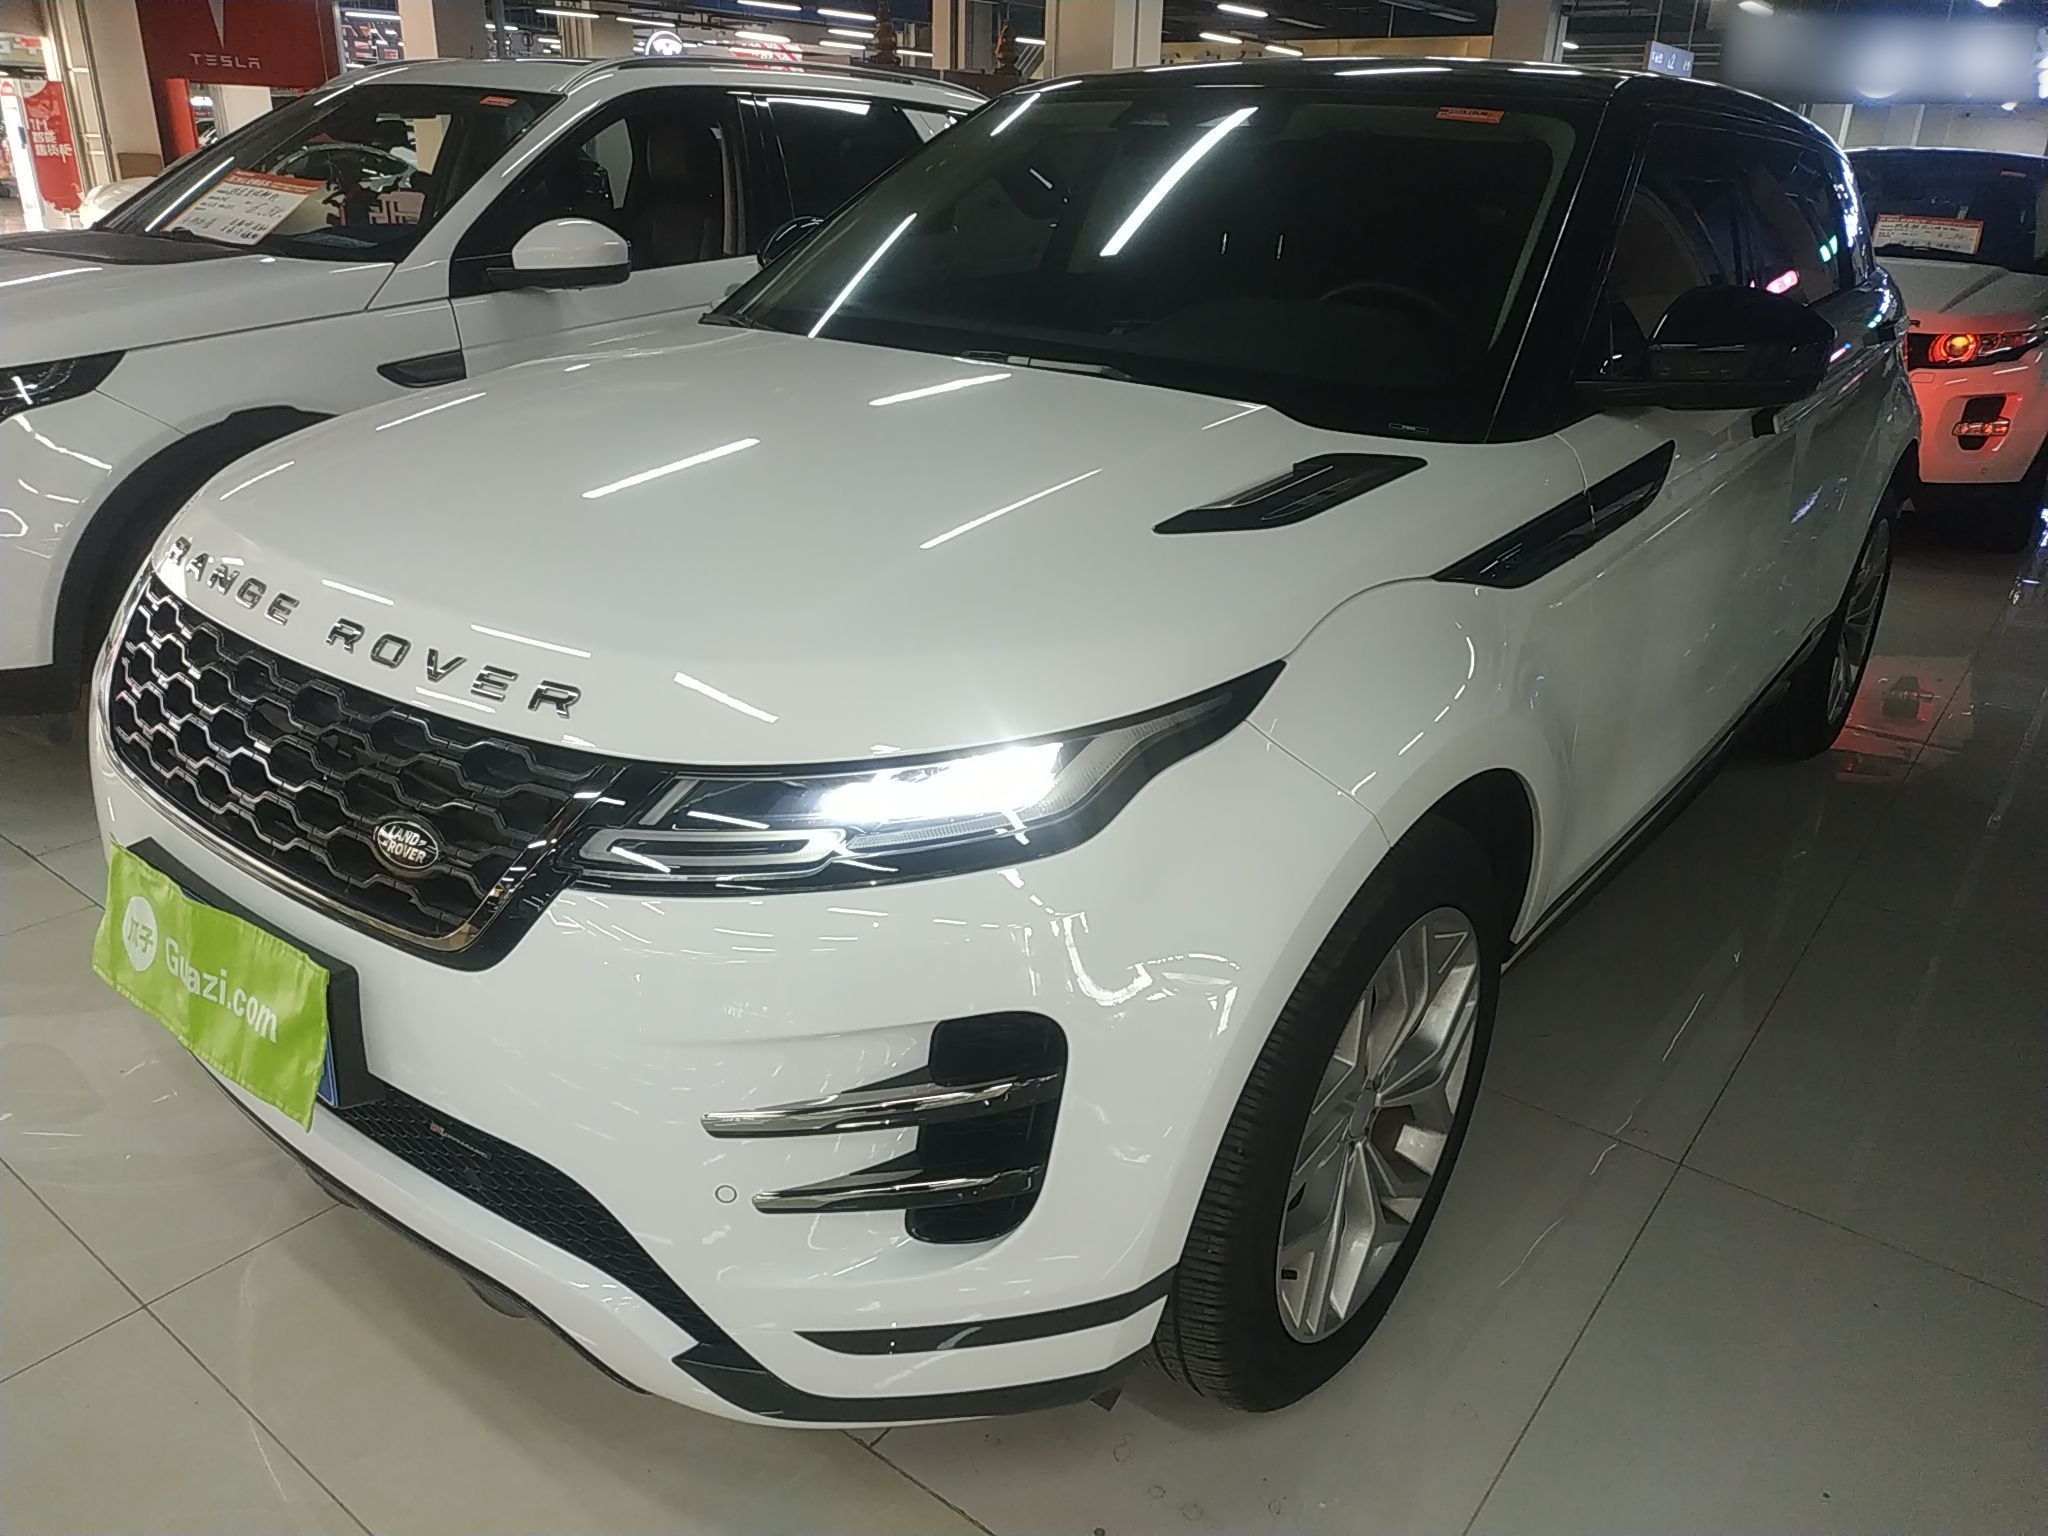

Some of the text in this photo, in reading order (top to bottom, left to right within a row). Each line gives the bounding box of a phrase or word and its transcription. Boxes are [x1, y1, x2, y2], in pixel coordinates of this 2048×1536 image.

[189, 52, 262, 70] TESLA
[35, 143, 73, 163] 售货柜
[168, 536, 582, 720] RANGE ROVER
[387, 825, 421, 846] LAND
[387, 840, 427, 863] ROVER
[127, 916, 154, 954] 瓜子
[165, 936, 279, 1043] Guazi.com
